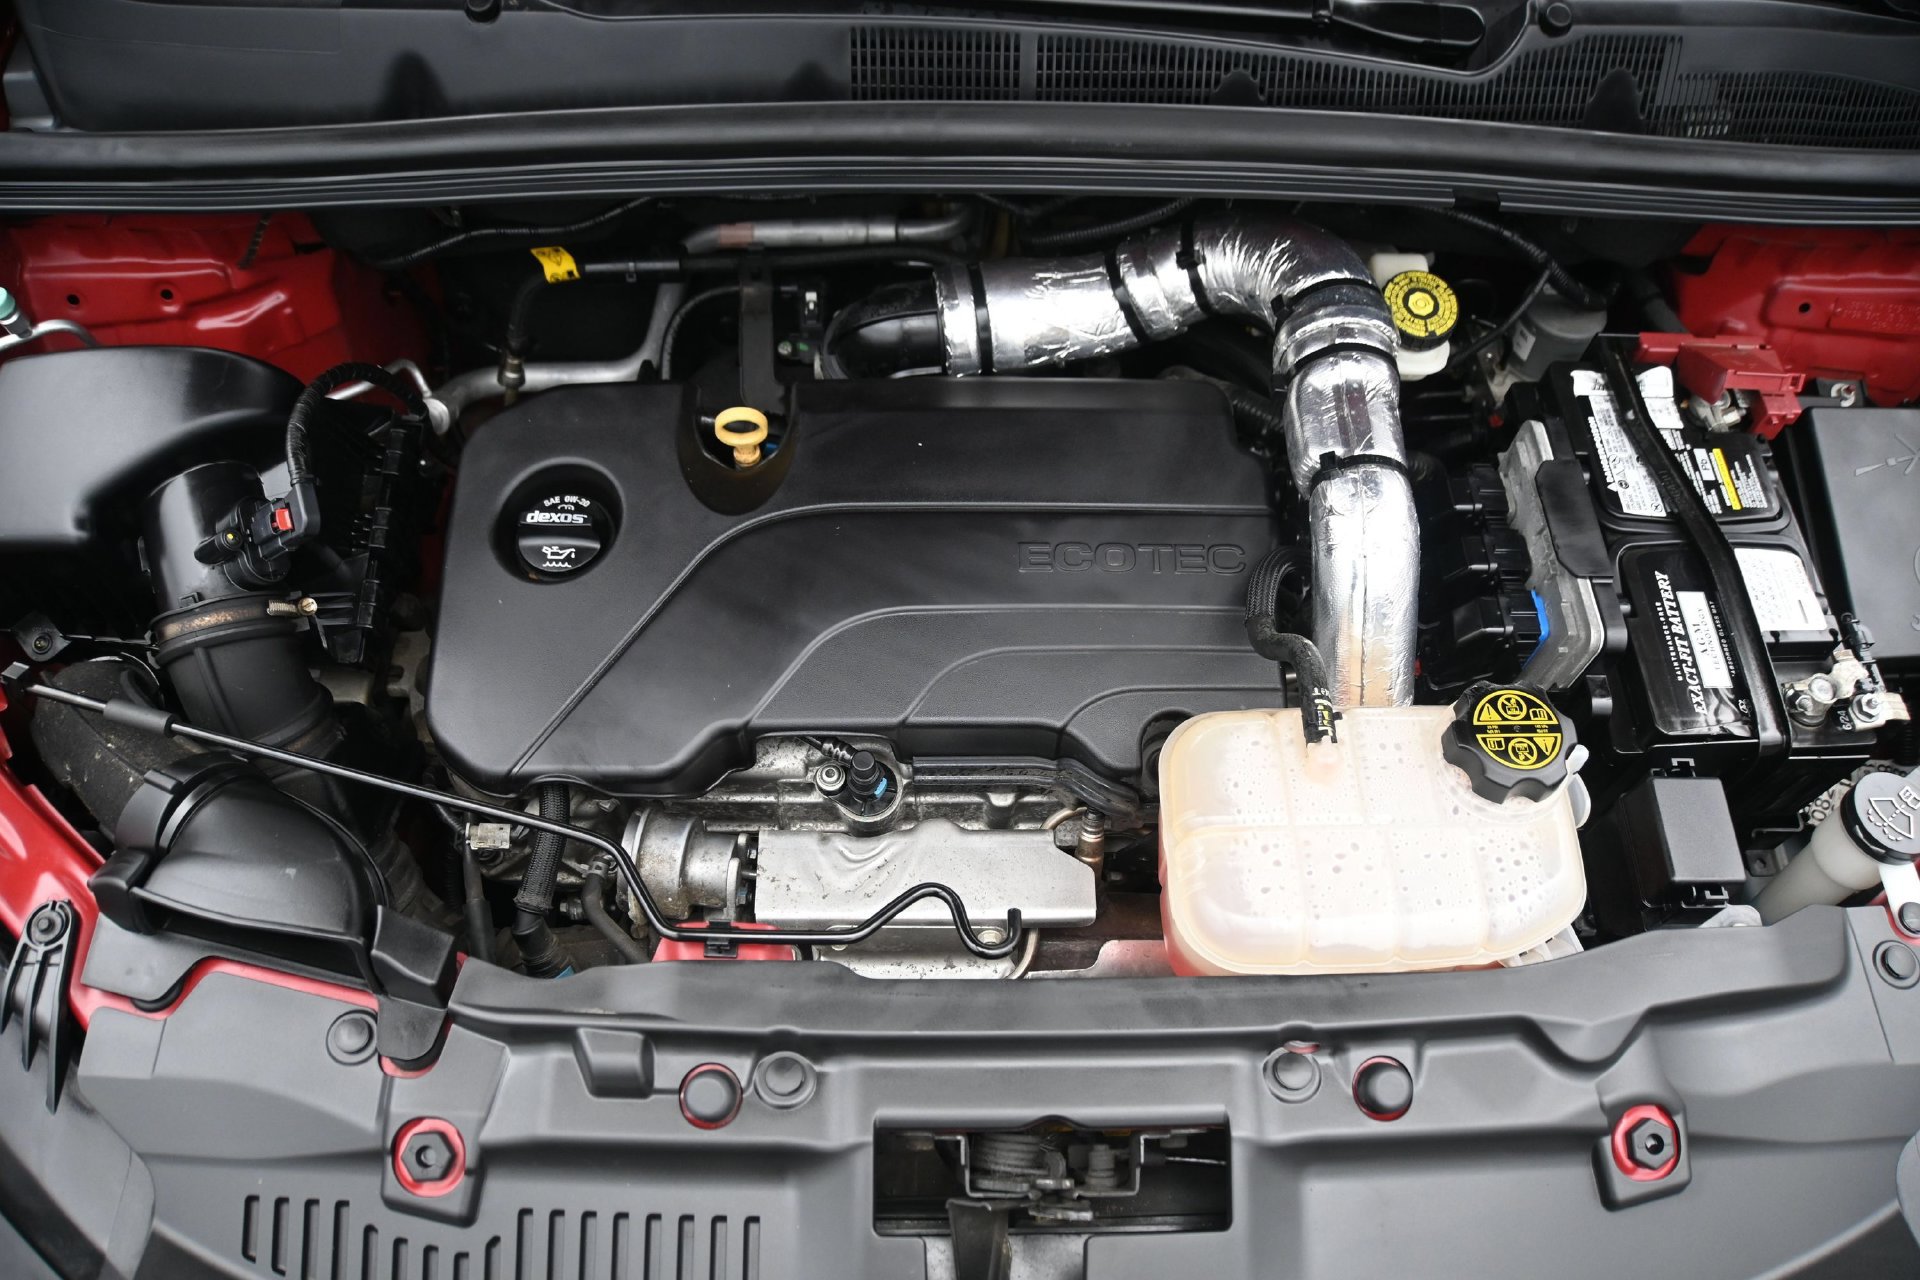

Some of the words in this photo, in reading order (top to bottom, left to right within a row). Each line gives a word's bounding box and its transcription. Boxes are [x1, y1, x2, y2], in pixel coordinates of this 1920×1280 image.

[526, 510, 588, 524] dexos
[543, 496, 560, 507] SAE
[1017, 541, 1247, 576] ECOTEC
[1654, 570, 1686, 635] BATTERY
[1655, 601, 1683, 681] MAINTENANCE-FREE
[1674, 636, 1708, 715] EXACT-FIT
